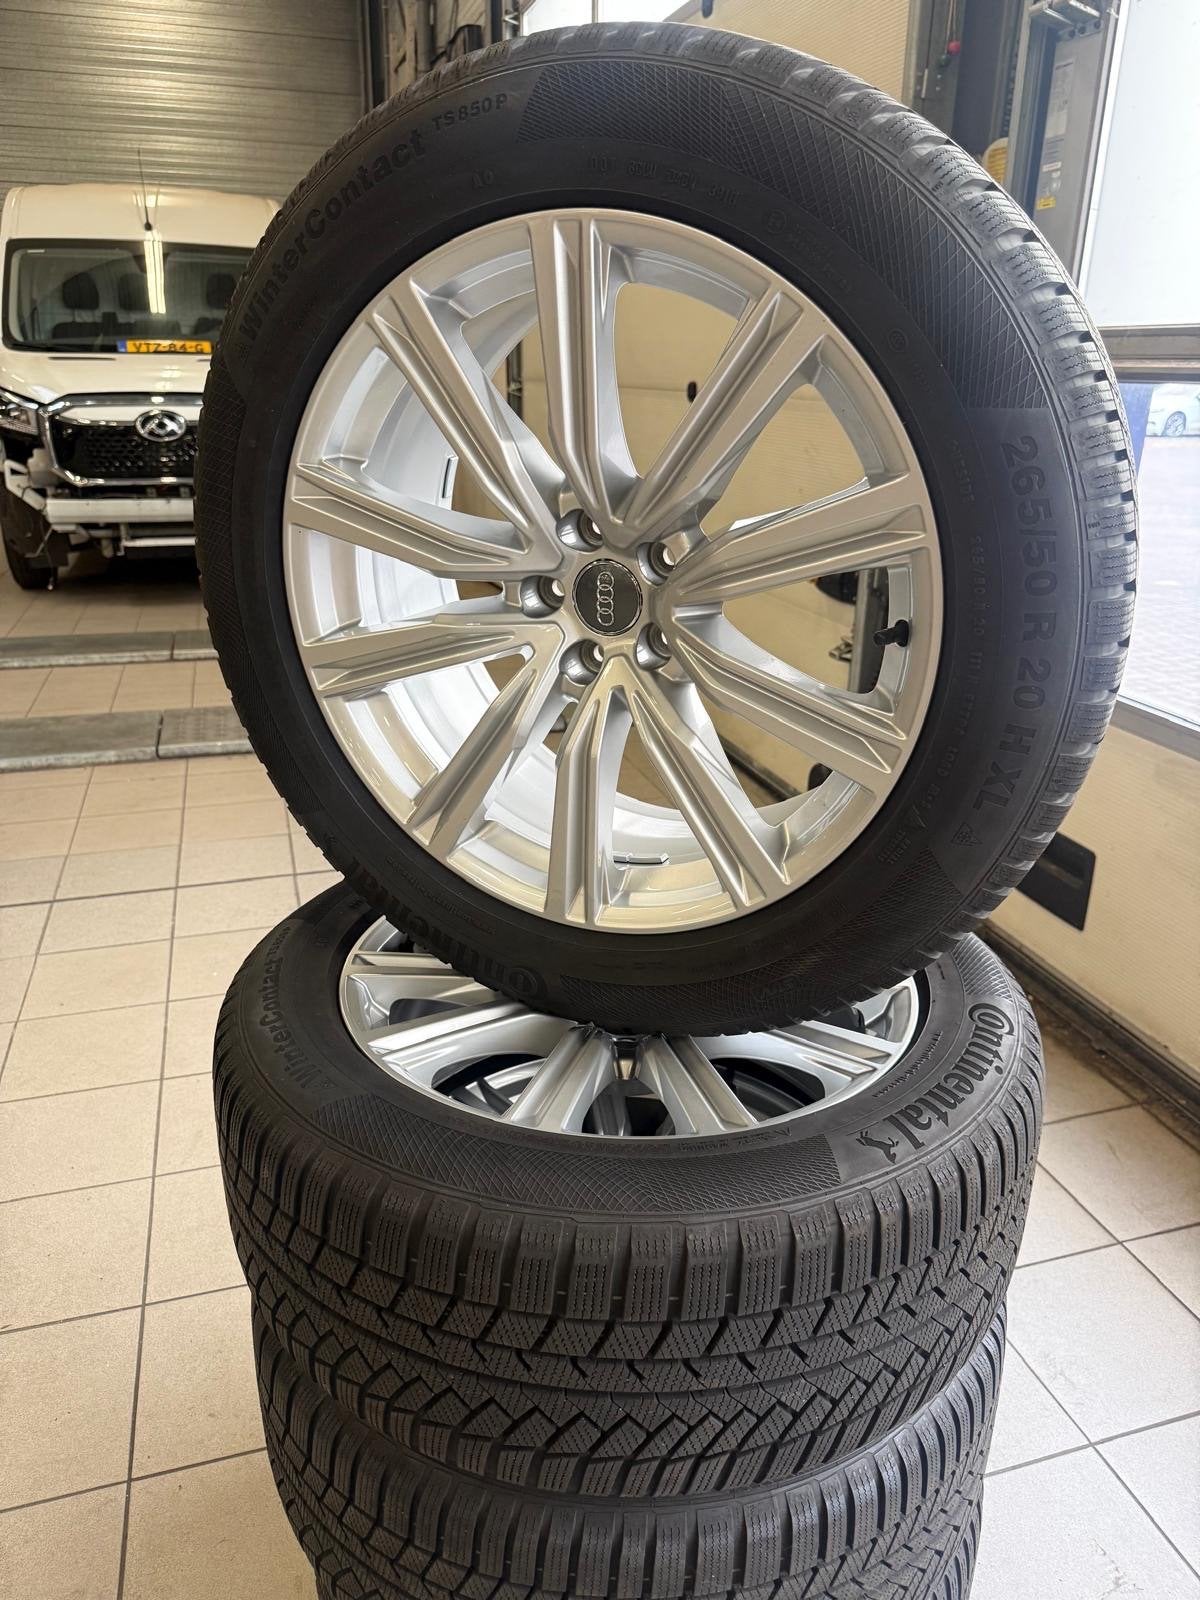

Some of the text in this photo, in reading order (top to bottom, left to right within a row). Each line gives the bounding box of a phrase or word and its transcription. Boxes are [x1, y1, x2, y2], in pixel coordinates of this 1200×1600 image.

[238, 128, 427, 342] WinterContact
[972, 435, 1058, 810] 265/50 R 20 H XL
[882, 1002, 1014, 1149] Continental
